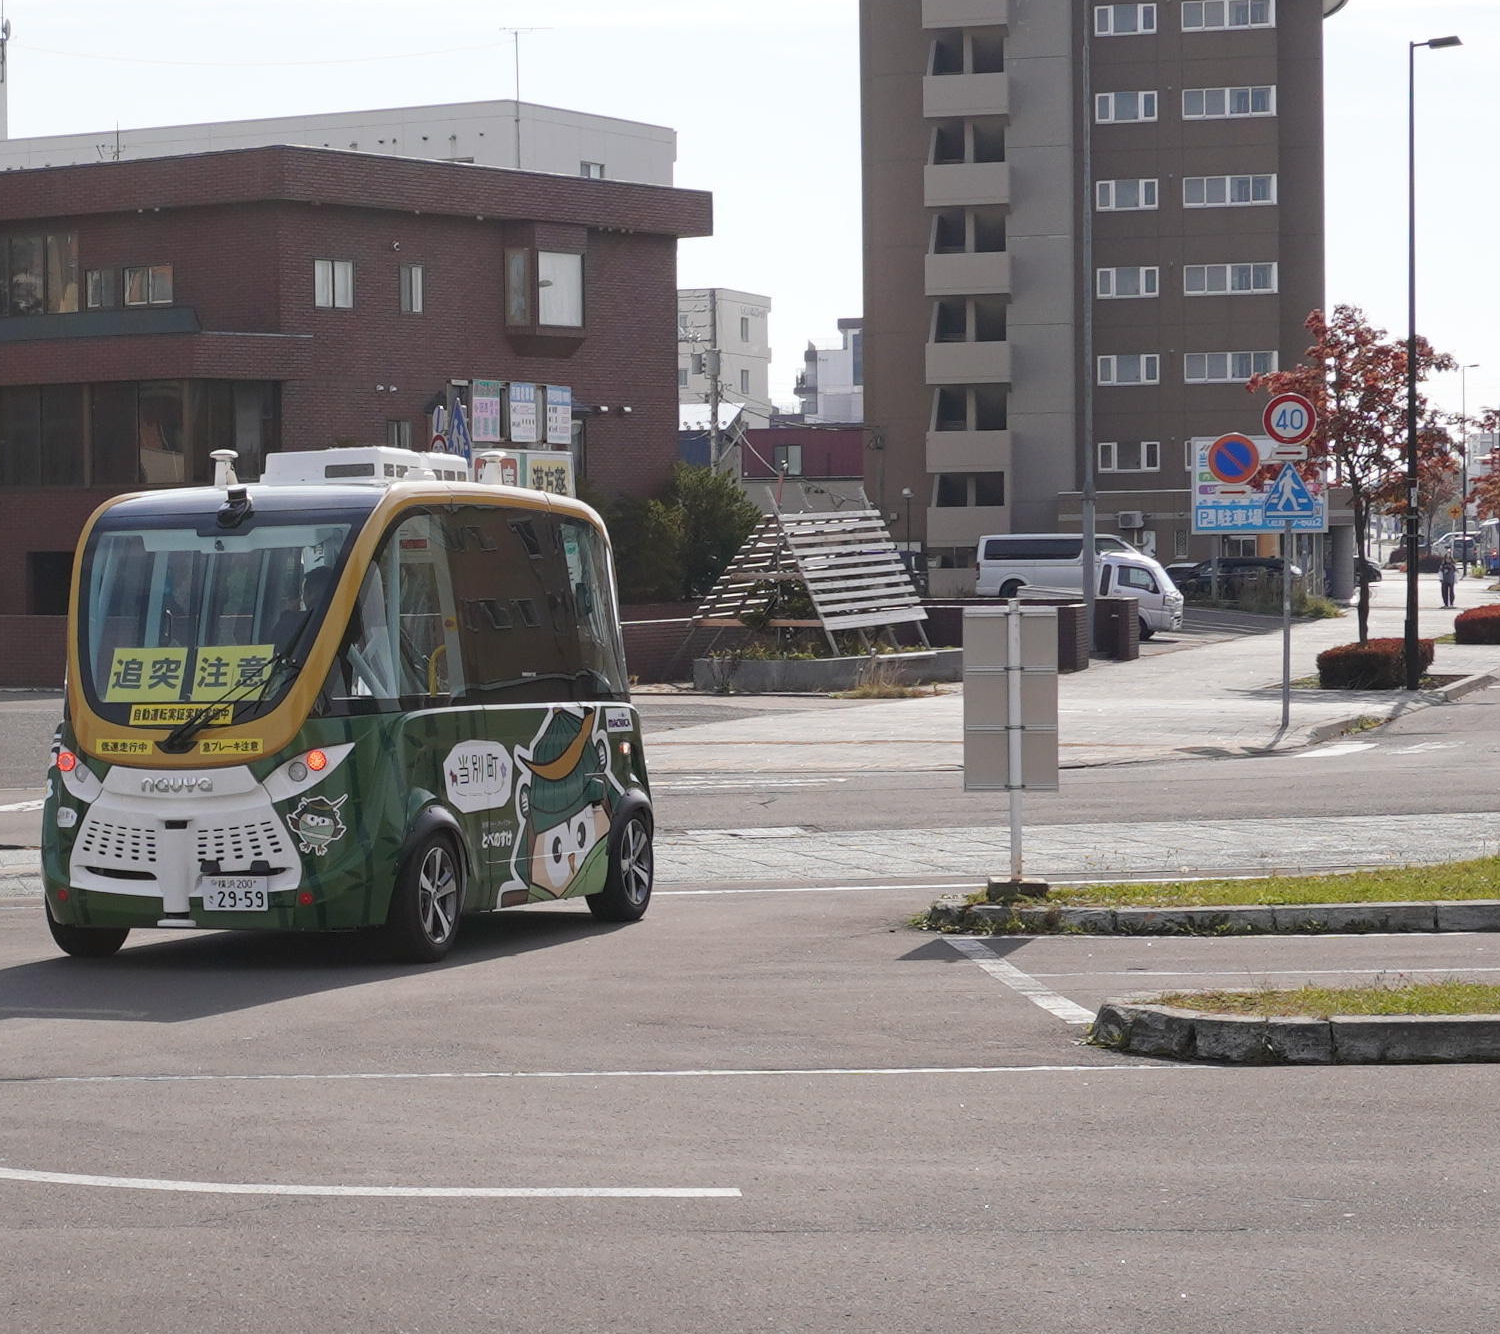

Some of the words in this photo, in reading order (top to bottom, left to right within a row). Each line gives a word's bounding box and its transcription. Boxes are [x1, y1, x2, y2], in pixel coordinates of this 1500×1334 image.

[1275, 408, 1304, 431] 40
[1216, 508, 1264, 527] 駐車場
[111, 657, 182, 690] 追突
[197, 655, 268, 689] 注意
[202, 741, 259, 753] 急ブレーキ注意
[458, 753, 499, 785] 当別町
[217, 890, 265, 908] 29-59
